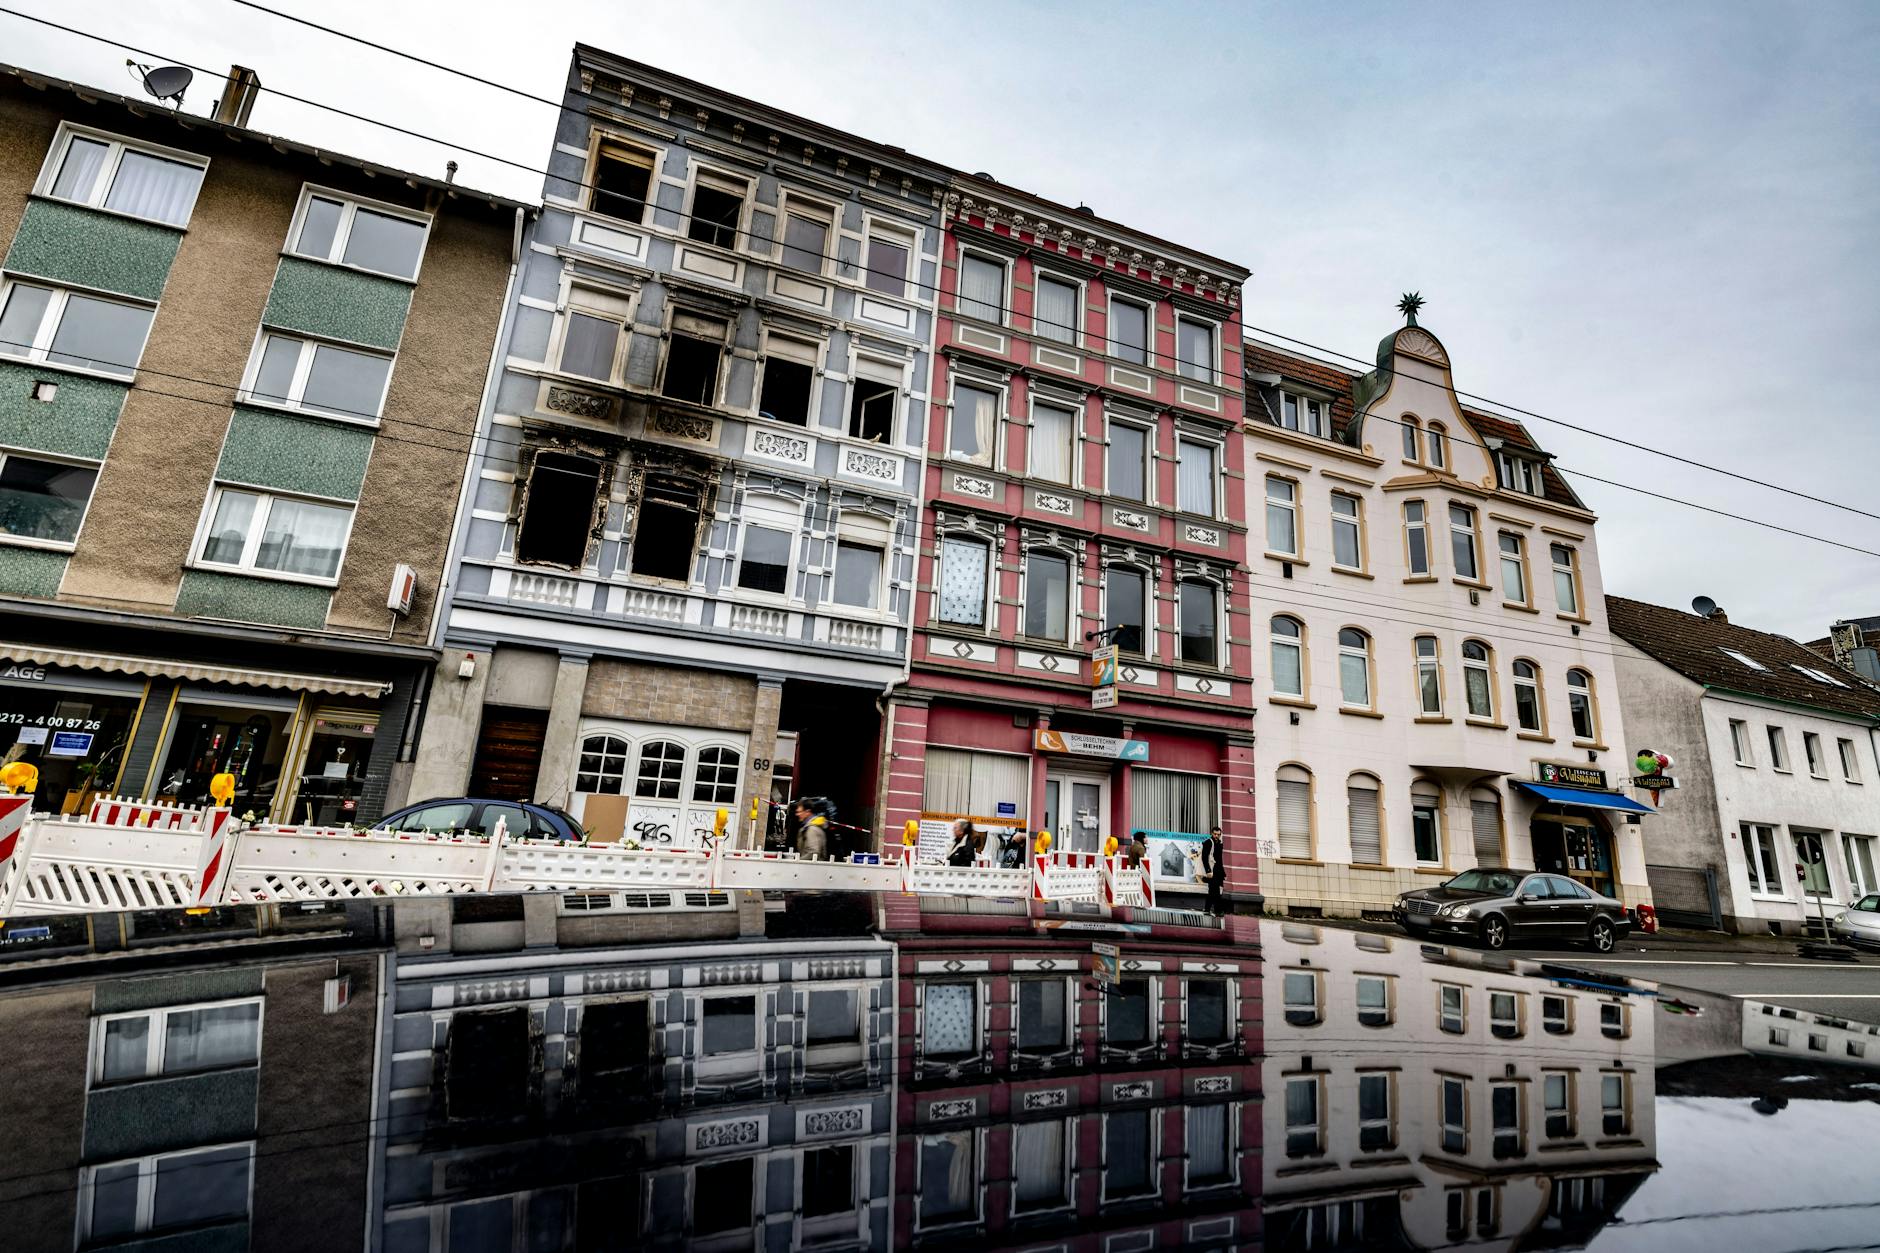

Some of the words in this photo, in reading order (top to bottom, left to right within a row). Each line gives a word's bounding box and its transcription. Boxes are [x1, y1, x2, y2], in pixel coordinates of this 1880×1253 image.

[0, 712, 25, 724] 212
[35, 716, 45, 726] 4
[47, 717, 64, 727] 00
[66, 719, 83, 729] 87
[84, 720, 101, 731] 26
[1082, 742, 1105, 751] BEHM
[753, 759, 770, 771] 69
